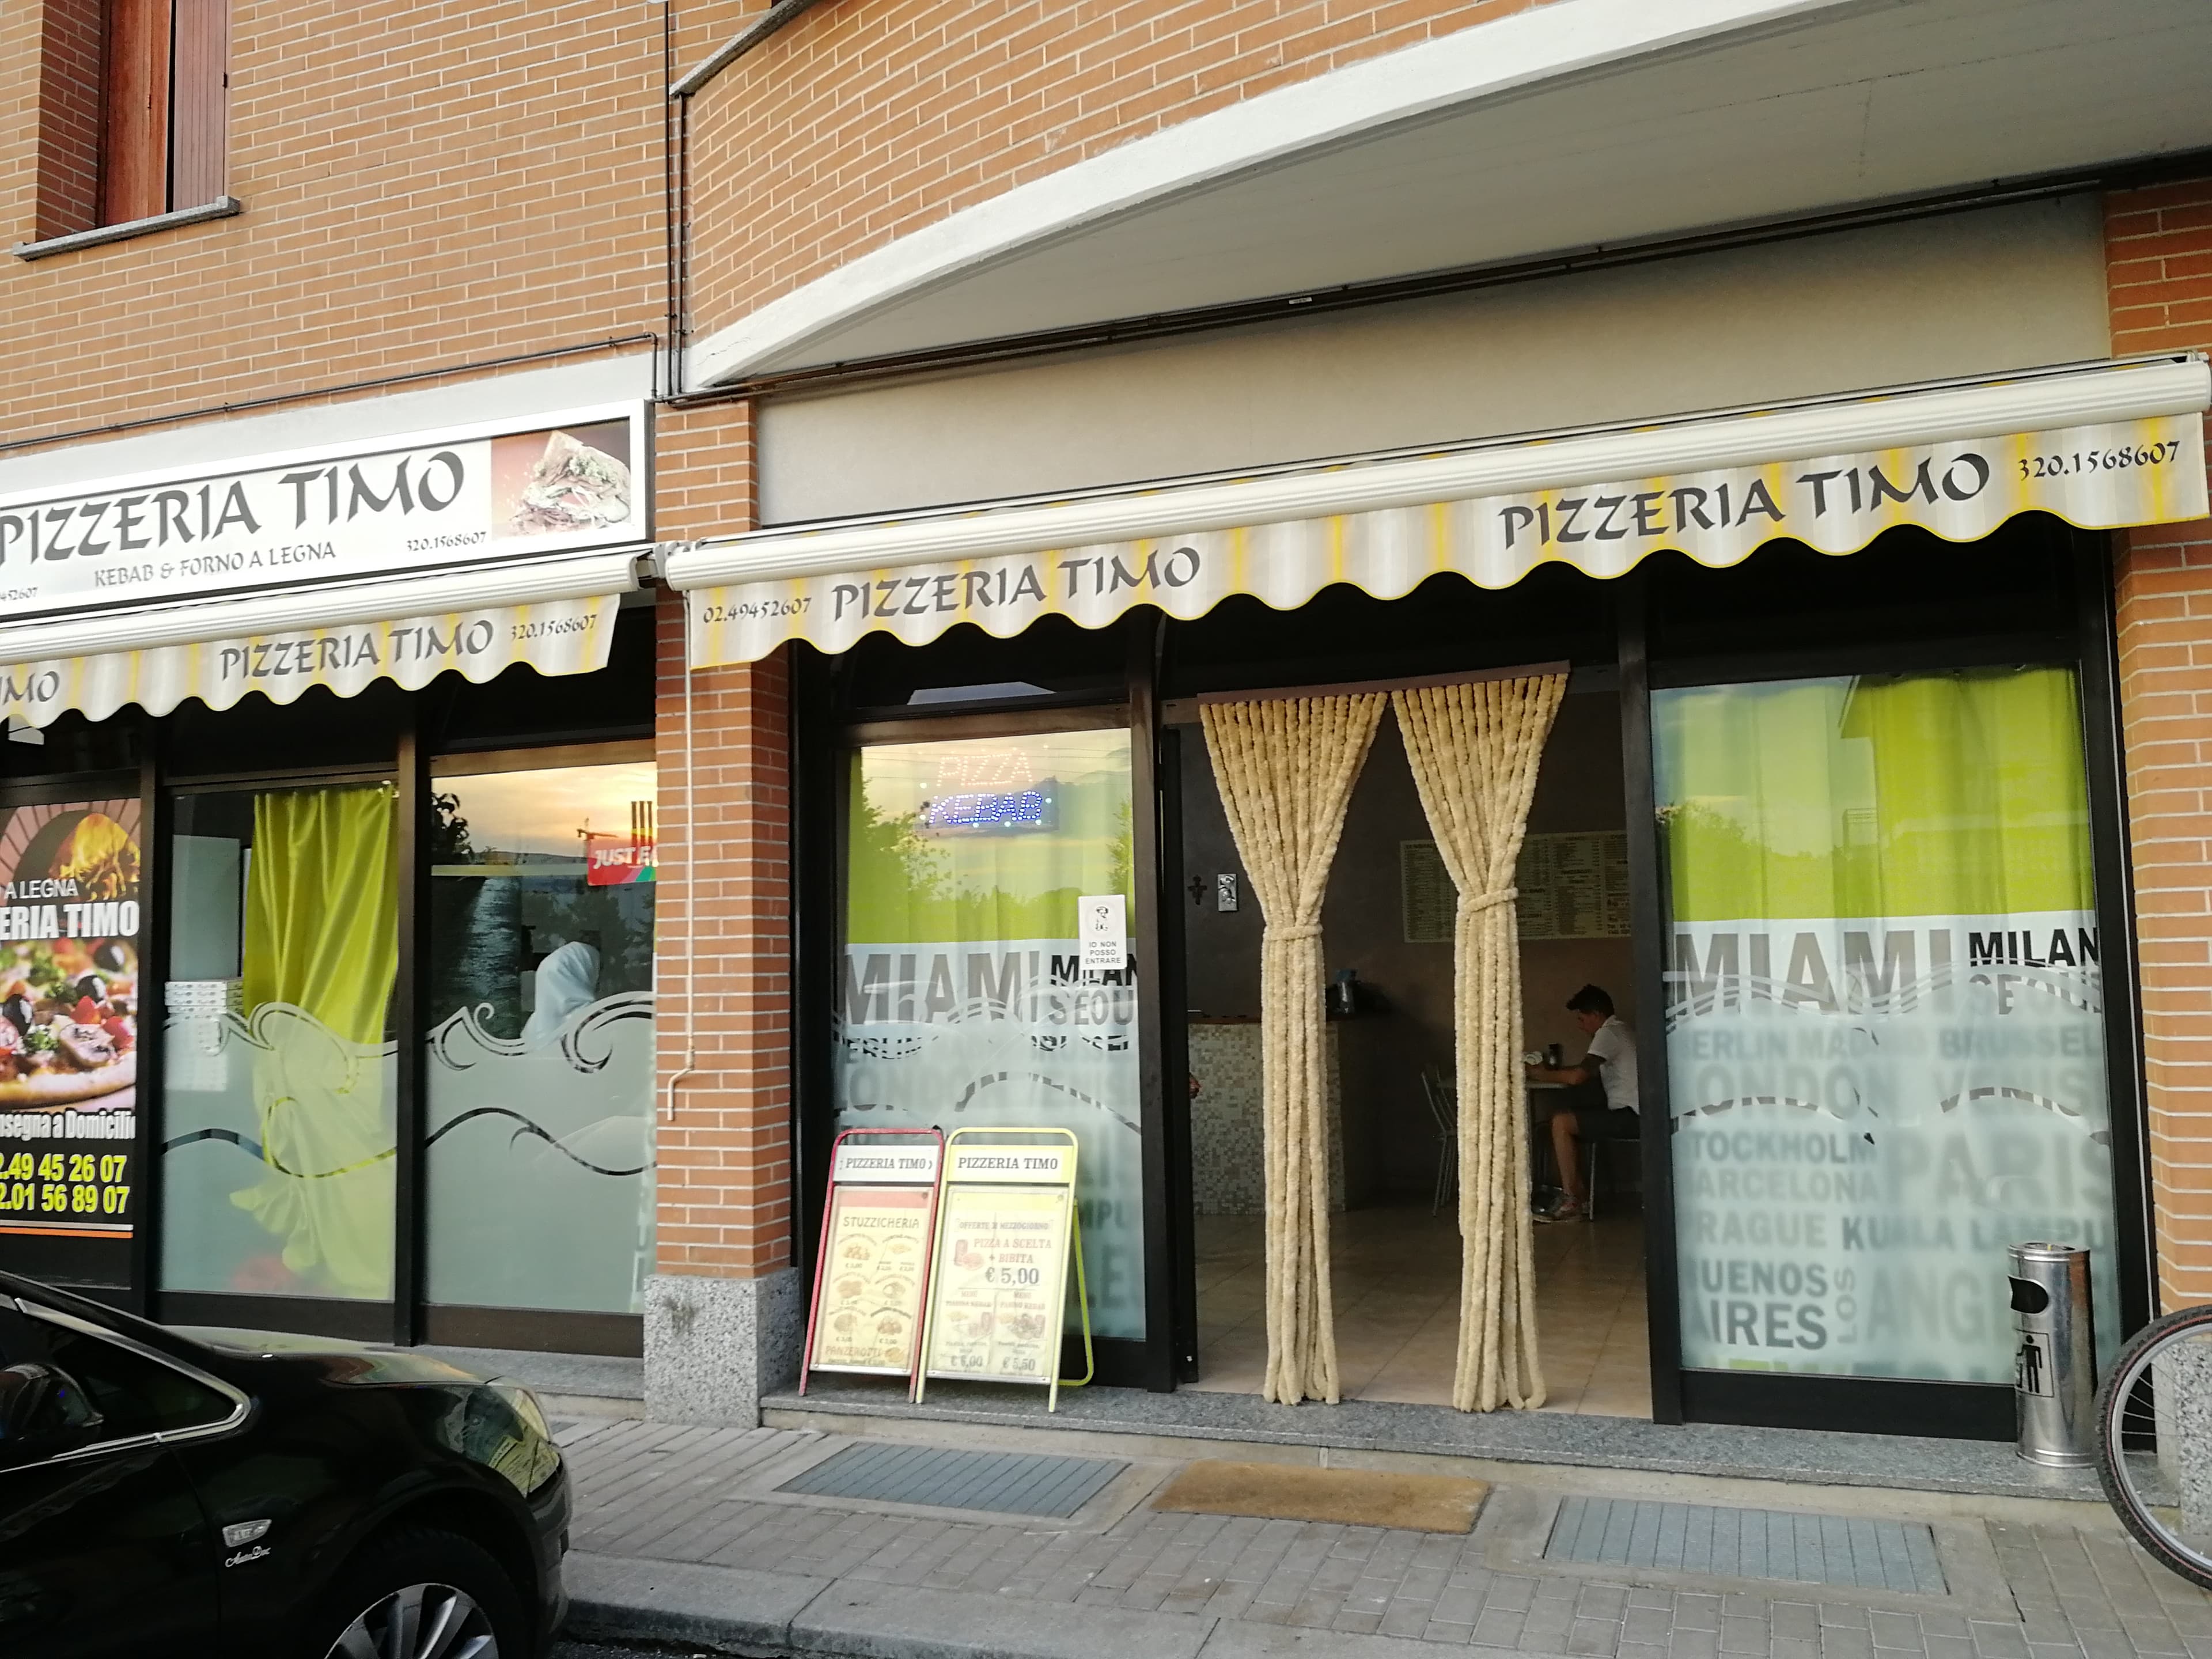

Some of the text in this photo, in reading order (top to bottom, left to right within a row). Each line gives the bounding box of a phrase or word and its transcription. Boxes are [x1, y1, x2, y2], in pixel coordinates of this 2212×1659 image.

[0, 451, 465, 566] PIZZERIA TIMO
[1501, 441, 2181, 551] PIZZERIA TIMO 320.1568607
[407, 531, 487, 552] 320.1568607
[94, 541, 337, 588] KEBAB & FORNO A LEGNA
[0, 587, 38, 601] 452607
[703, 547, 1201, 624] 02.49452607 PIZZERIA TIMO
[219, 614, 598, 681] PIZZERIA TIMO 320.1568607
[937, 750, 1033, 787] PIZZA
[928, 790, 1043, 824] KEBAB
[593, 846, 636, 870] JUST
[4, 878, 79, 899] A LEGNA
[63, 900, 140, 938] TIMO
[1675, 927, 2099, 1016] MIAMI MILAN
[845, 950, 1040, 1025] MIAMI
[52, 1115, 65, 1138] a
[38, 1153, 65, 1182] 45
[68, 1154, 96, 1183] 26
[100, 1155, 128, 1183] 07
[846, 1158, 926, 1170] PIZZERIA TIMO
[957, 1157, 1058, 1171] PIZZERIA TIMO
[41, 1184, 68, 1212] 56
[72, 1185, 99, 1213] 89
[103, 1185, 131, 1214] 07
[843, 1216, 920, 1229] STUZZICHERIA
[959, 1222, 990, 1230] OFFERTE
[974, 1238, 1052, 1249] PIZZA A SCELTA
[998, 1253, 1034, 1263] BIBITA
[985, 1267, 1040, 1285] € 5,00
